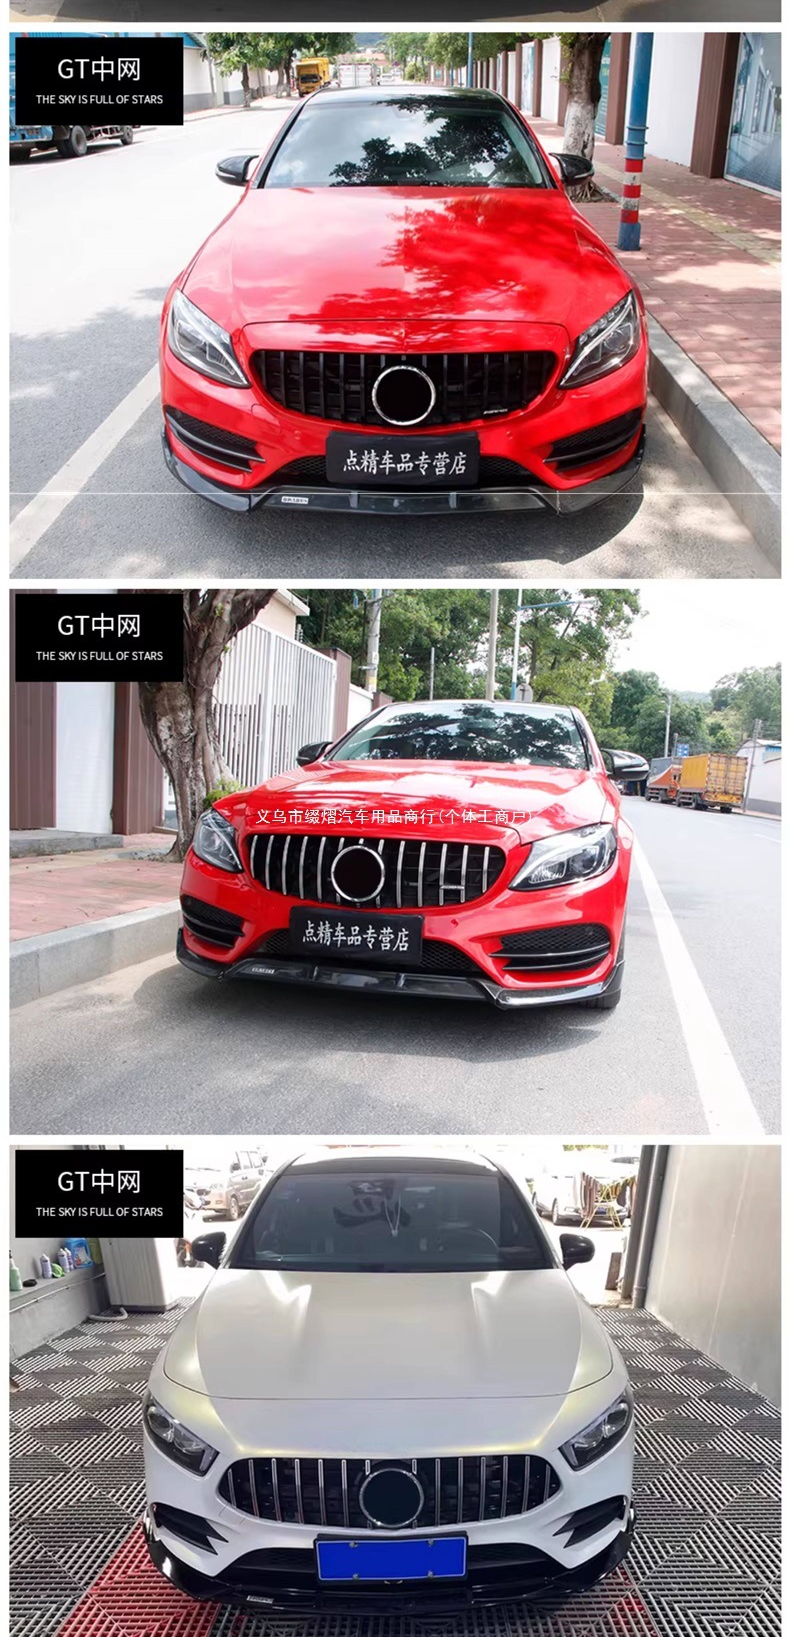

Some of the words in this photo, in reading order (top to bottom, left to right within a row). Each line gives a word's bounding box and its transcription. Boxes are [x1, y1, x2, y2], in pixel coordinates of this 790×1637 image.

[343, 449, 467, 476] 点精车品专营店
[302, 920, 409, 951] 点精车品专营店
